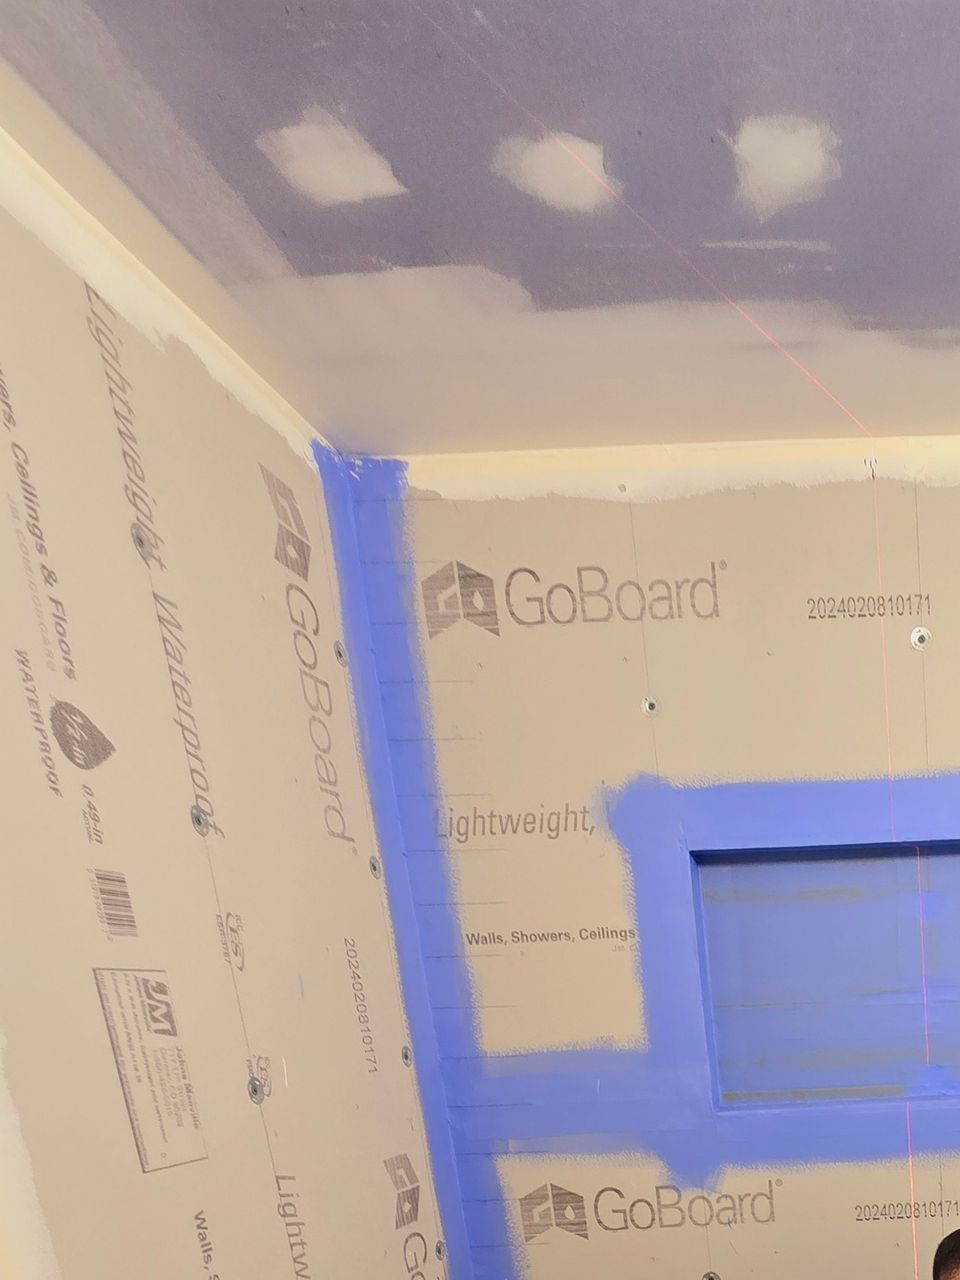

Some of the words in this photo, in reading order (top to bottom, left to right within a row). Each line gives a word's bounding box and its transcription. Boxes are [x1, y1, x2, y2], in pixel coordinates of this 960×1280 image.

[40, 562, 58, 588] &
[807, 593, 931, 619] 2024020810171
[48, 595, 76, 681] Floors
[466, 933, 507, 946] Walls,
[511, 930, 576, 944] Showers,
[579, 926, 636, 942] Ceilings
[344, 936, 378, 1074] 2024020810171
[855, 1200, 960, 1221] 2024020810171
[194, 1209, 214, 1270] Walls,
